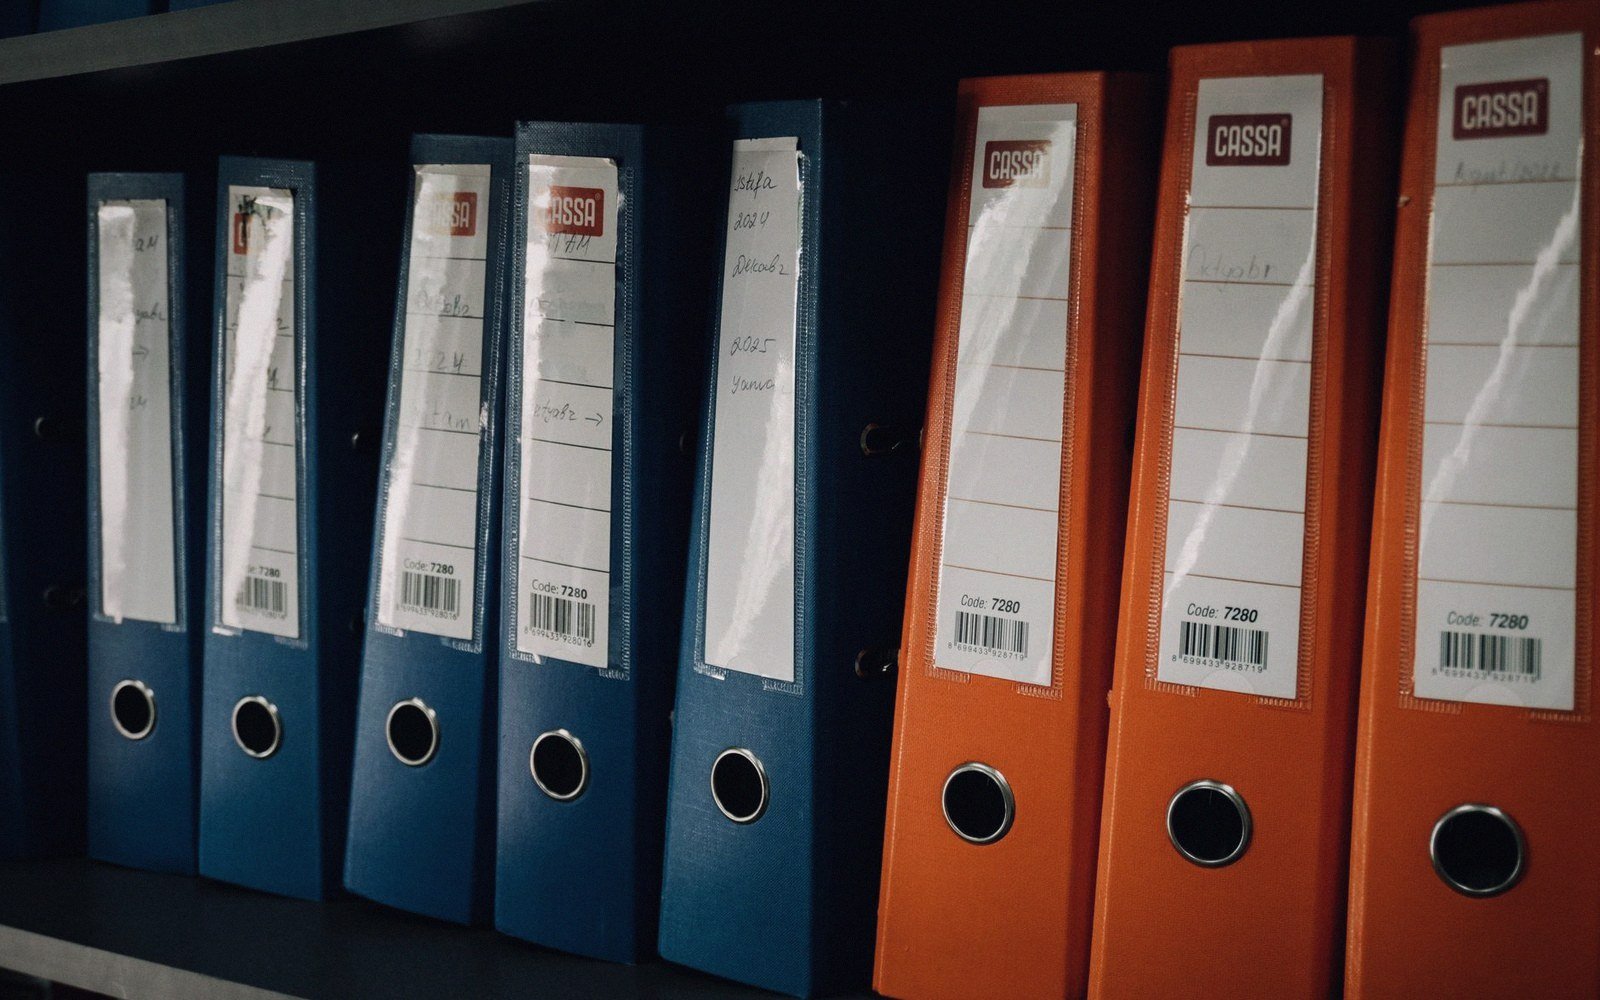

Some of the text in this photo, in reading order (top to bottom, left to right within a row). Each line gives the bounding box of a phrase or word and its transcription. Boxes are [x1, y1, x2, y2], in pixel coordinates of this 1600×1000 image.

[1462, 91, 1539, 130] CASSA
[1214, 125, 1282, 157] CASSA
[989, 150, 1044, 180] CASSA
[546, 196, 596, 228] ASSA
[734, 211, 770, 231] 2024
[730, 335, 776, 356] 2025
[259, 566, 281, 578] 7280
[403, 558, 455, 576] Code: 7280
[531, 578, 588, 600] Code: 7280
[960, 594, 1021, 614] Code: 7280
[1187, 602, 1258, 623] Code: 7280
[1447, 611, 1530, 630] Code: 7280
